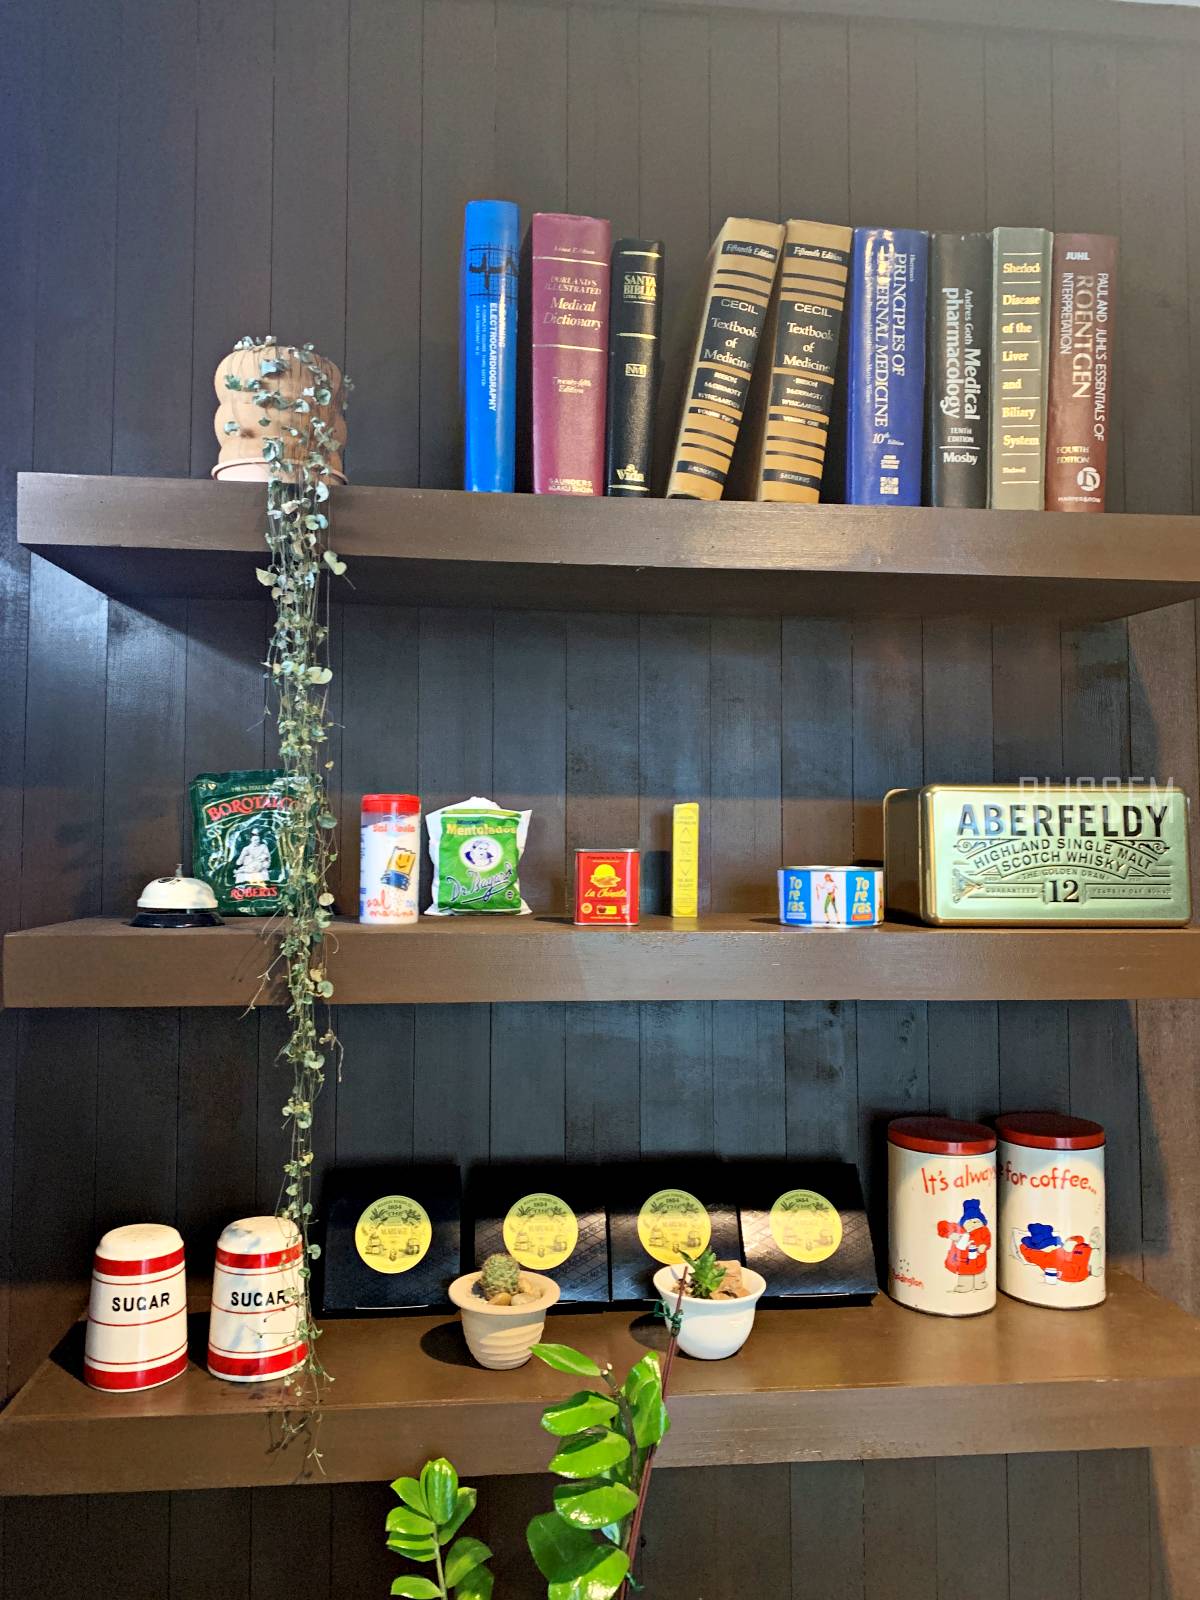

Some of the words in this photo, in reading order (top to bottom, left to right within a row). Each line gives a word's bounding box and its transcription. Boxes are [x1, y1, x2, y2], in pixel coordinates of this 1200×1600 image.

[726, 243, 754, 254] Fifteenth
[753, 247, 775, 259] Edition
[821, 250, 843, 262] Edition
[1065, 251, 1092, 261] JUHL
[623, 274, 657, 287] SANTA
[1095, 272, 1109, 299] PAUL
[623, 284, 657, 298] BIBLIA
[875, 251, 891, 341] INERNAL
[551, 296, 597, 313] Medical
[720, 299, 759, 315] CECIL
[794, 303, 833, 318] CECIL
[891, 253, 907, 351] PRINCIPLES
[964, 288, 974, 321] Andres
[1095, 299, 1109, 324] AND
[543, 312, 603, 331] Dictionary
[1059, 272, 1075, 355] INTERPRETATION
[712, 317, 759, 338] Textbook
[787, 322, 834, 342] Textbook
[964, 323, 974, 345] Goth
[1002, 323, 1015, 334] of
[1016, 322, 1033, 333] the
[1072, 274, 1096, 398] ROENTGEN
[725, 338, 738, 349] of
[803, 341, 816, 353] of
[940, 287, 964, 420] pharmacology
[1094, 327, 1108, 362] JUHL'S
[488, 302, 498, 412] ELECTROCARDIOGRAPHY
[703, 349, 752, 369] Medicine
[783, 354, 831, 372] Medicine
[891, 354, 905, 377] OF
[1002, 351, 1029, 362] Liver
[874, 344, 889, 428] MEDICINE
[964, 348, 981, 420] Medical
[1002, 378, 1022, 390] and
[1093, 363, 1108, 422] ESSENTIALS
[1002, 406, 1037, 420] Biliary
[947, 435, 974, 444] EDITION
[950, 427, 972, 435] TENTH
[1092, 422, 1106, 441] OF
[1002, 434, 1041, 449] System
[943, 452, 979, 466] Mosby
[446, 822, 516, 836] Mentolados
[956, 803, 1169, 838] ABERFELDY
[973, 838, 1051, 870] HIGHLAND
[1056, 838, 1112, 856] SINGLE
[1117, 848, 1154, 870] MALT
[1001, 850, 1061, 873] SCOTCH
[1066, 851, 1126, 873] WHISKY
[1021, 870, 1038, 880] THE
[1041, 868, 1078, 877] GOLDEN
[1080, 868, 1106, 880] DRAM
[230, 886, 278, 901] ROBERTS
[1048, 879, 1081, 902] 12
[921, 1167, 949, 1196] It's
[953, 1163, 997, 1189] alway
[1005, 1160, 1027, 1185] for
[1030, 1167, 1097, 1195] coffee...
[111, 1291, 171, 1312] SUGAR
